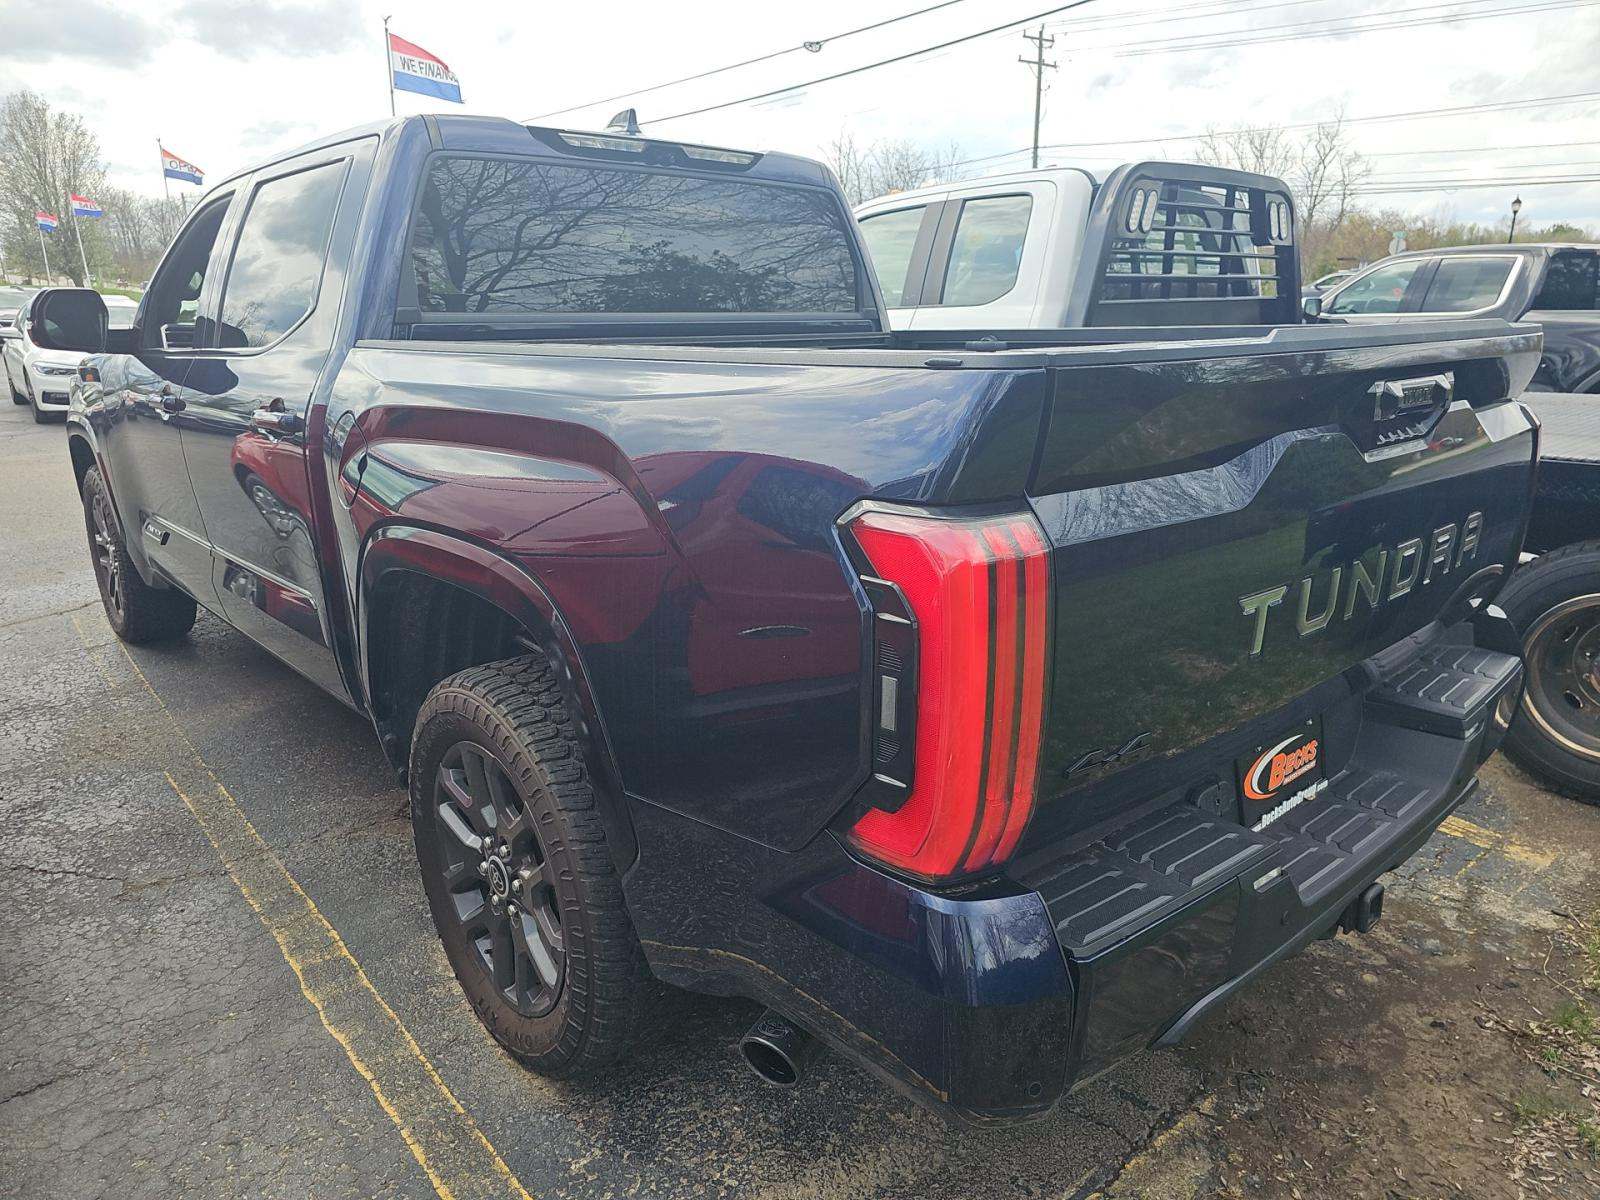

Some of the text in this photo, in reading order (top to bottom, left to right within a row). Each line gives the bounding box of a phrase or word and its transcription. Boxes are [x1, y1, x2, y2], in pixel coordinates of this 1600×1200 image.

[399, 55, 459, 82] WE FINAN
[1238, 511, 1483, 655] TUNDRA
[1268, 740, 1318, 791] BECKS
